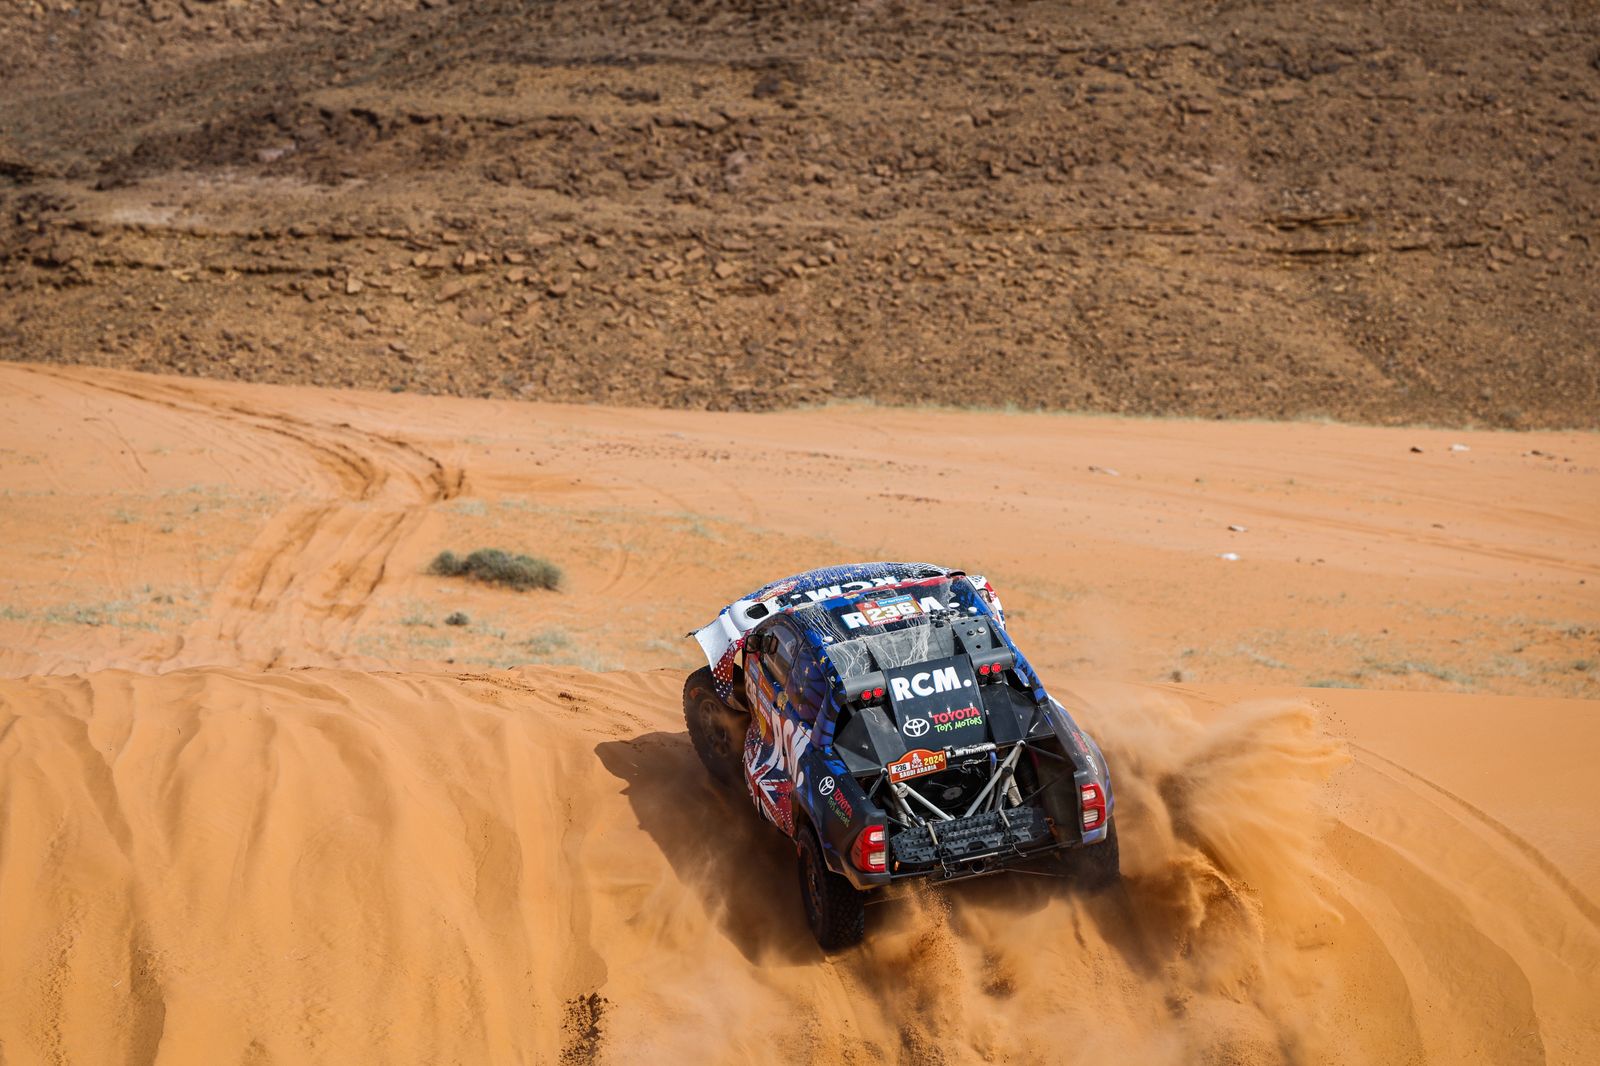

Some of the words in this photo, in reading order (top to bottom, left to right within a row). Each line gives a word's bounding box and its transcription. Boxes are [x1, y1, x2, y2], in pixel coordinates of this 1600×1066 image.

[867, 602, 916, 622] 236
[891, 666, 972, 702] RCM.
[932, 706, 981, 725] TOYOTA
[934, 721, 953, 733] TOYS
[954, 716, 983, 730] MOTORS
[895, 763, 907, 773] 236
[923, 754, 944, 766] 2024
[899, 769, 916, 779] SAUDI
[916, 763, 938, 775] ARABIA
[833, 787, 853, 819] TOYOTA
